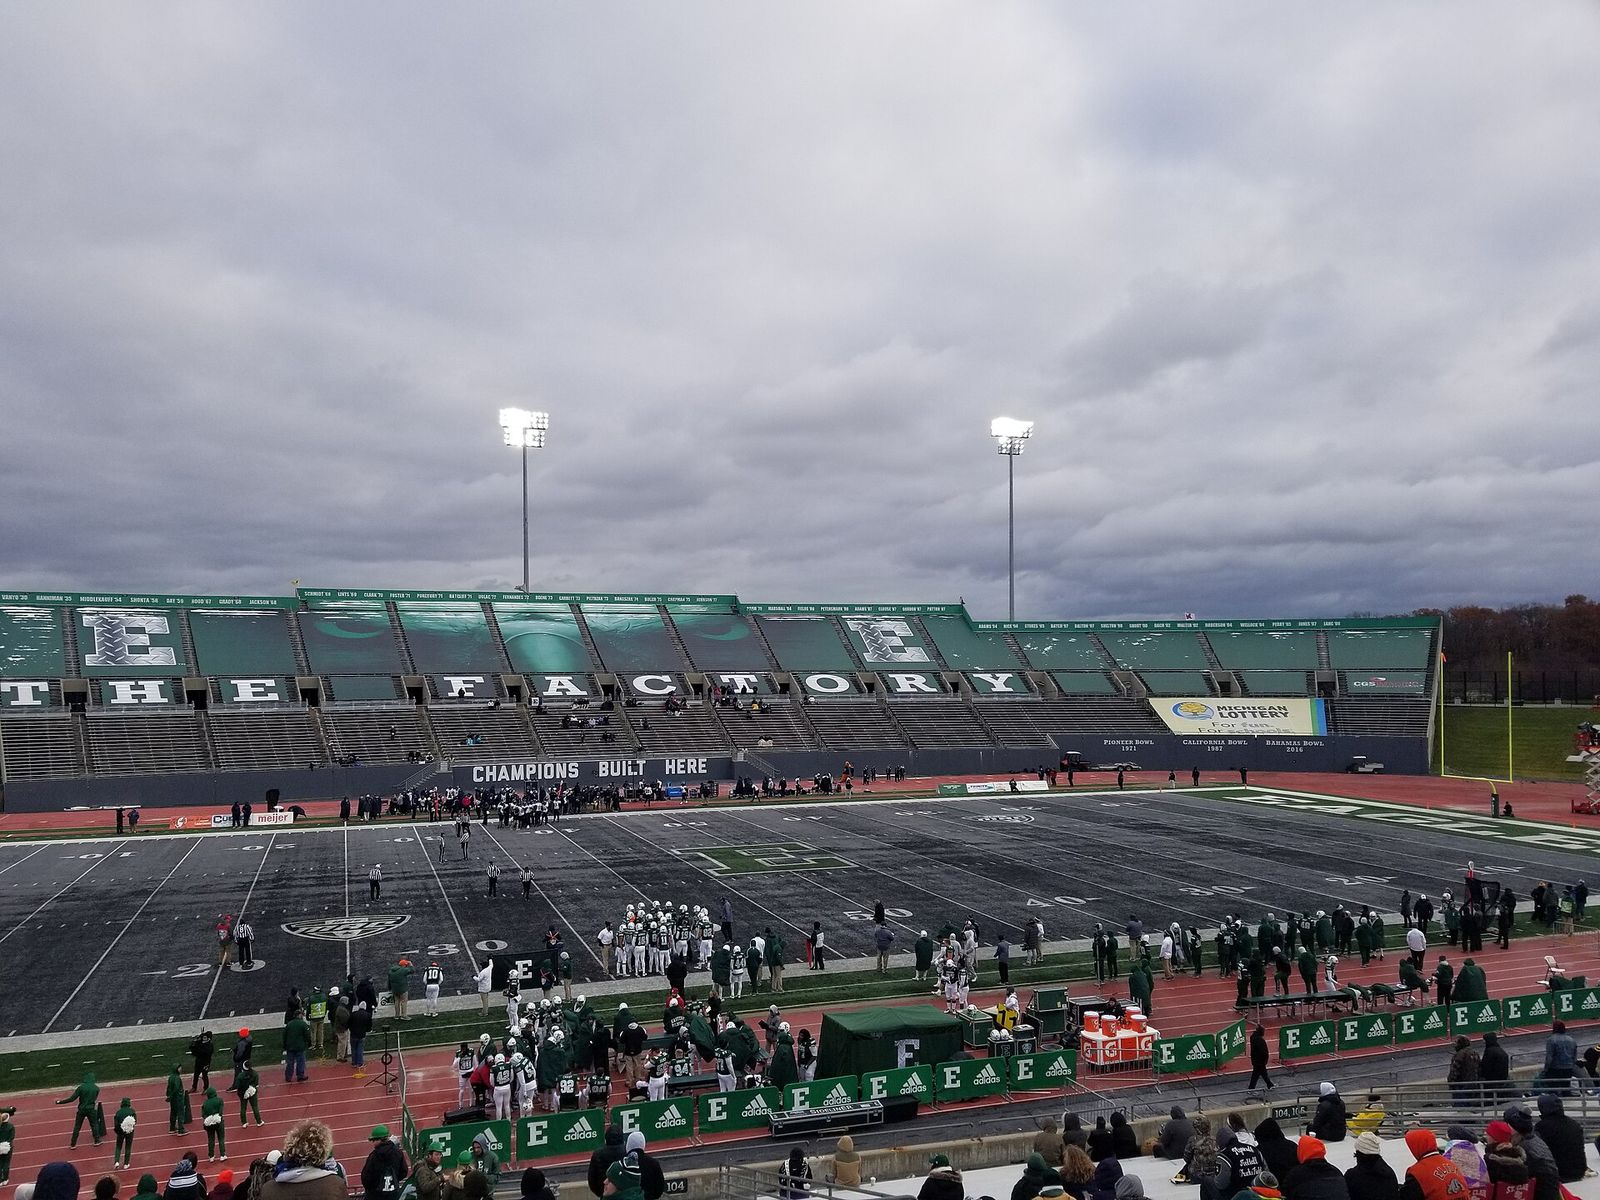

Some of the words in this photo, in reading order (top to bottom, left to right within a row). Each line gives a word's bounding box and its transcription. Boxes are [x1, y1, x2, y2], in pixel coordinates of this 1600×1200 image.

[82, 614, 176, 666] E
[846, 621, 930, 662] E
[473, 762, 579, 782] CHAMPIONS
[598, 760, 646, 778] BUILT
[666, 758, 708, 775] HERE
[258, 813, 288, 824] meijer
[1223, 795, 1600, 854] EAGLE
[671, 842, 859, 876] E
[1326, 876, 1390, 885] 20
[1178, 886, 1246, 896] 30
[1027, 896, 1086, 908] 40
[843, 908, 914, 920] 50
[427, 940, 508, 956] 30
[661, 936, 667, 945] 11
[171, 960, 266, 978] 20
[428, 969, 438, 979] 10
[515, 960, 532, 980] E
[1508, 1000, 1520, 1019] E
[1529, 1008, 1548, 1016] adidas
[1560, 994, 1573, 1012] E
[1401, 1015, 1415, 1034] E
[1423, 1021, 1443, 1030] adidas
[1456, 1007, 1468, 1026] E
[1477, 1014, 1497, 1024] adidas
[1286, 1029, 1300, 1049] E
[1309, 1036, 1330, 1046] adidas
[1344, 1021, 1358, 1041] E
[1367, 1029, 1388, 1038] adidas
[1105, 1042, 1117, 1057] G
[1220, 1032, 1228, 1054] E
[1232, 1036, 1245, 1047] adidas
[1160, 1043, 1175, 1064] E
[1186, 1051, 1210, 1061] adidas
[674, 1064, 688, 1077] 94
[944, 1066, 960, 1089] E
[974, 1074, 1000, 1085] adidas
[1017, 1059, 1034, 1080] E
[1045, 1067, 1072, 1077] adidas
[560, 1080, 574, 1093] 92
[870, 1076, 887, 1099] E
[900, 1084, 927, 1095] adidas
[792, 1087, 810, 1110] E
[823, 1095, 851, 1107] adidas
[708, 1097, 727, 1122] E
[742, 1106, 772, 1117] adidas
[809, 1105, 853, 1114] SIDELINER
[1276, 1109, 1290, 1118] 104,
[620, 1109, 640, 1133] E
[655, 1117, 686, 1130] adidas
[527, 1121, 548, 1146] E
[564, 1129, 597, 1141] adidas
[430, 1132, 451, 1156] E
[667, 1182, 684, 1192] 104
